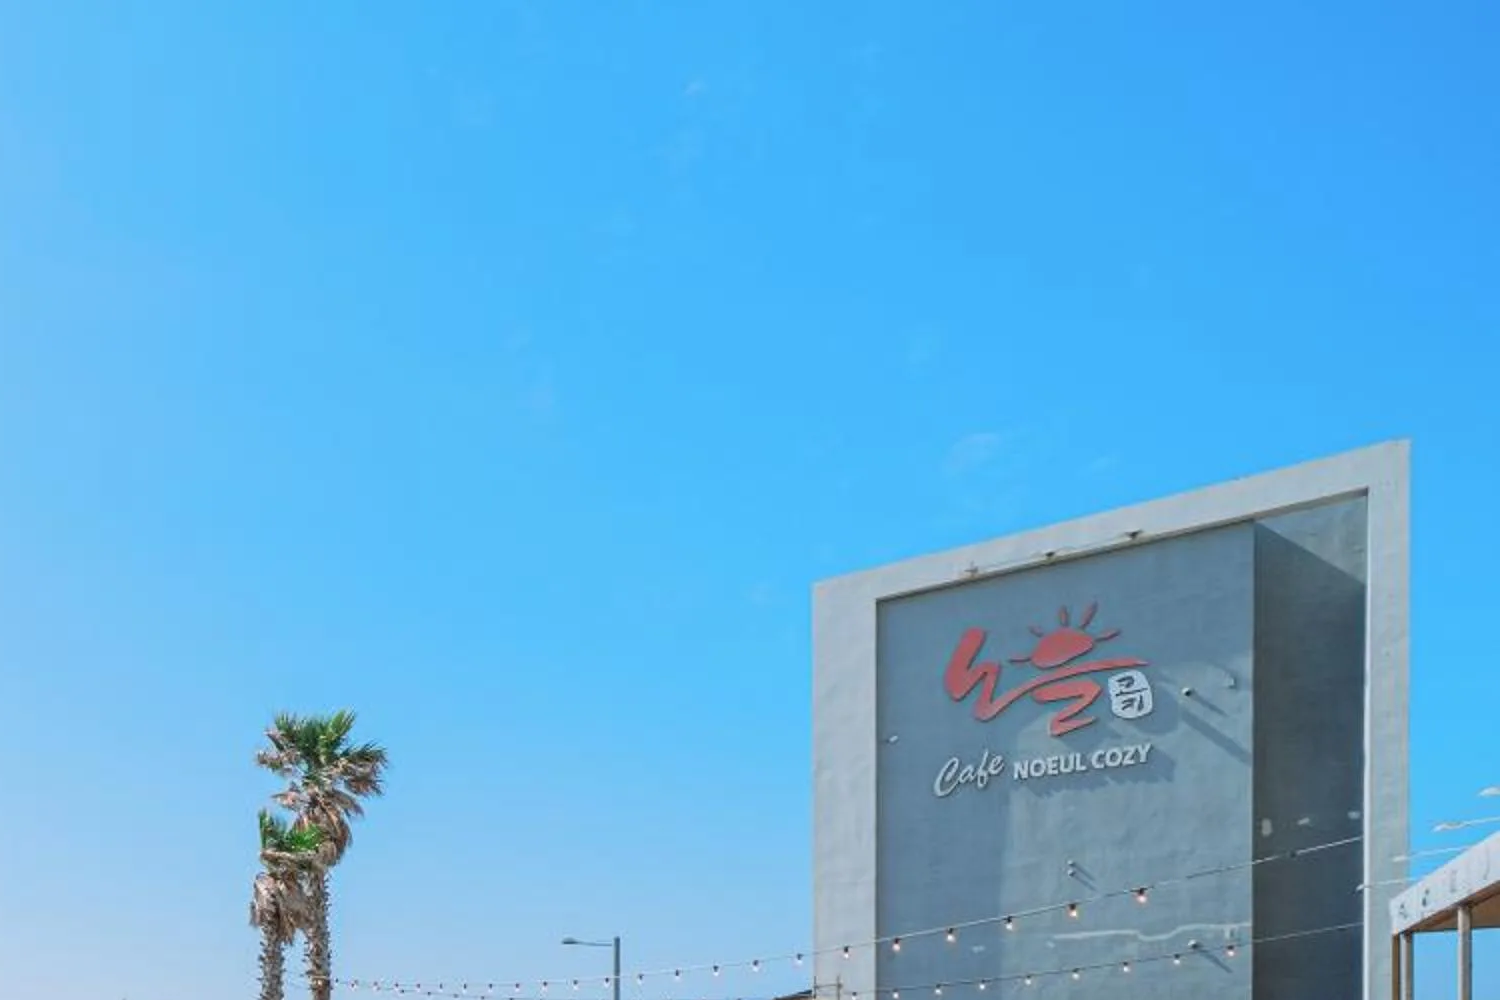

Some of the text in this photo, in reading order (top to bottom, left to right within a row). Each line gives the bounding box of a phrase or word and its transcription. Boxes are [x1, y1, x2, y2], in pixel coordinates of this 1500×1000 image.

[933, 743, 1152, 797] Cafe NOEUL COZY
